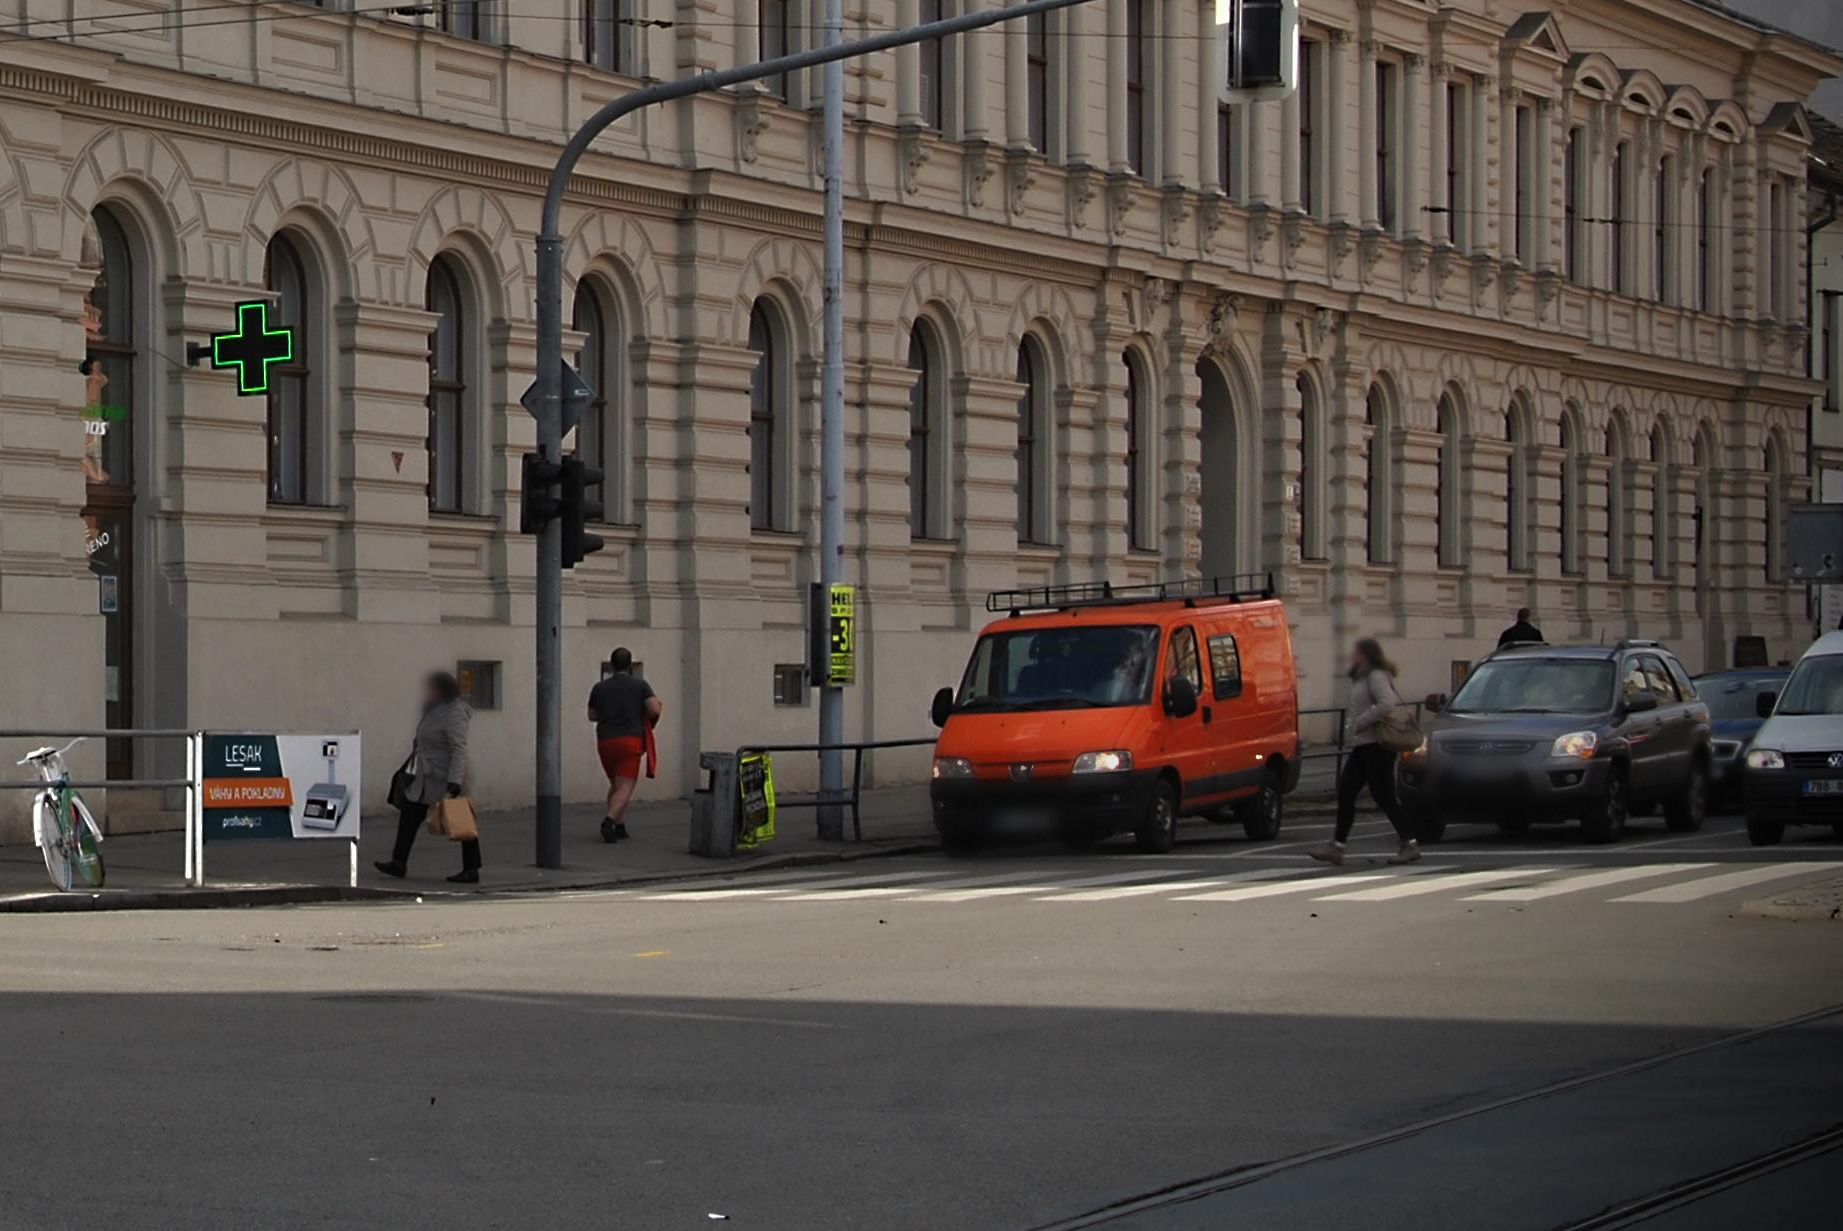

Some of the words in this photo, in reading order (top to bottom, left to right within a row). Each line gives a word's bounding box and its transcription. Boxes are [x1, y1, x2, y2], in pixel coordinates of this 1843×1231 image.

[225, 744, 262, 763] LESAK
[234, 787, 240, 800] A
[241, 786, 286, 800] POKLADNY
